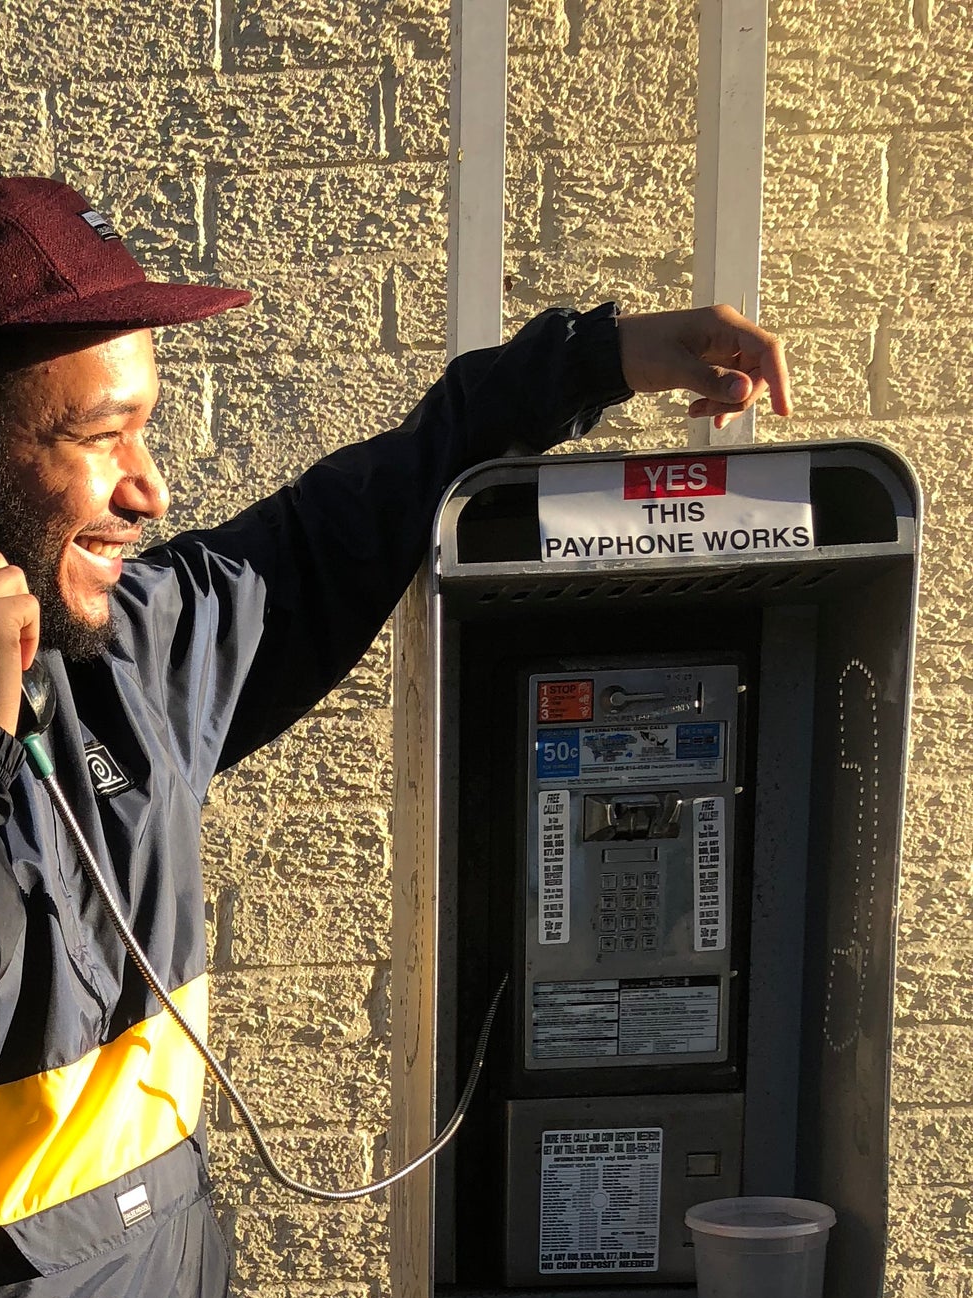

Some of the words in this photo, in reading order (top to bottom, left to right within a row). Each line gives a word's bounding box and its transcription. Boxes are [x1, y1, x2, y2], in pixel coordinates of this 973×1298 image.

[644, 463, 708, 492] YES
[642, 501, 705, 524] THIS
[545, 532, 694, 558] PAYPHONE
[703, 526, 810, 552] WORKS
[541, 685, 547, 696] 1
[549, 684, 577, 694] STOP
[540, 697, 549, 707] 2
[540, 709, 549, 719] 3
[547, 793, 560, 804] FREE
[701, 800, 715, 811] FREE
[541, 1262, 553, 1270] NO
[580, 1261, 616, 1269] DEPOSIT
